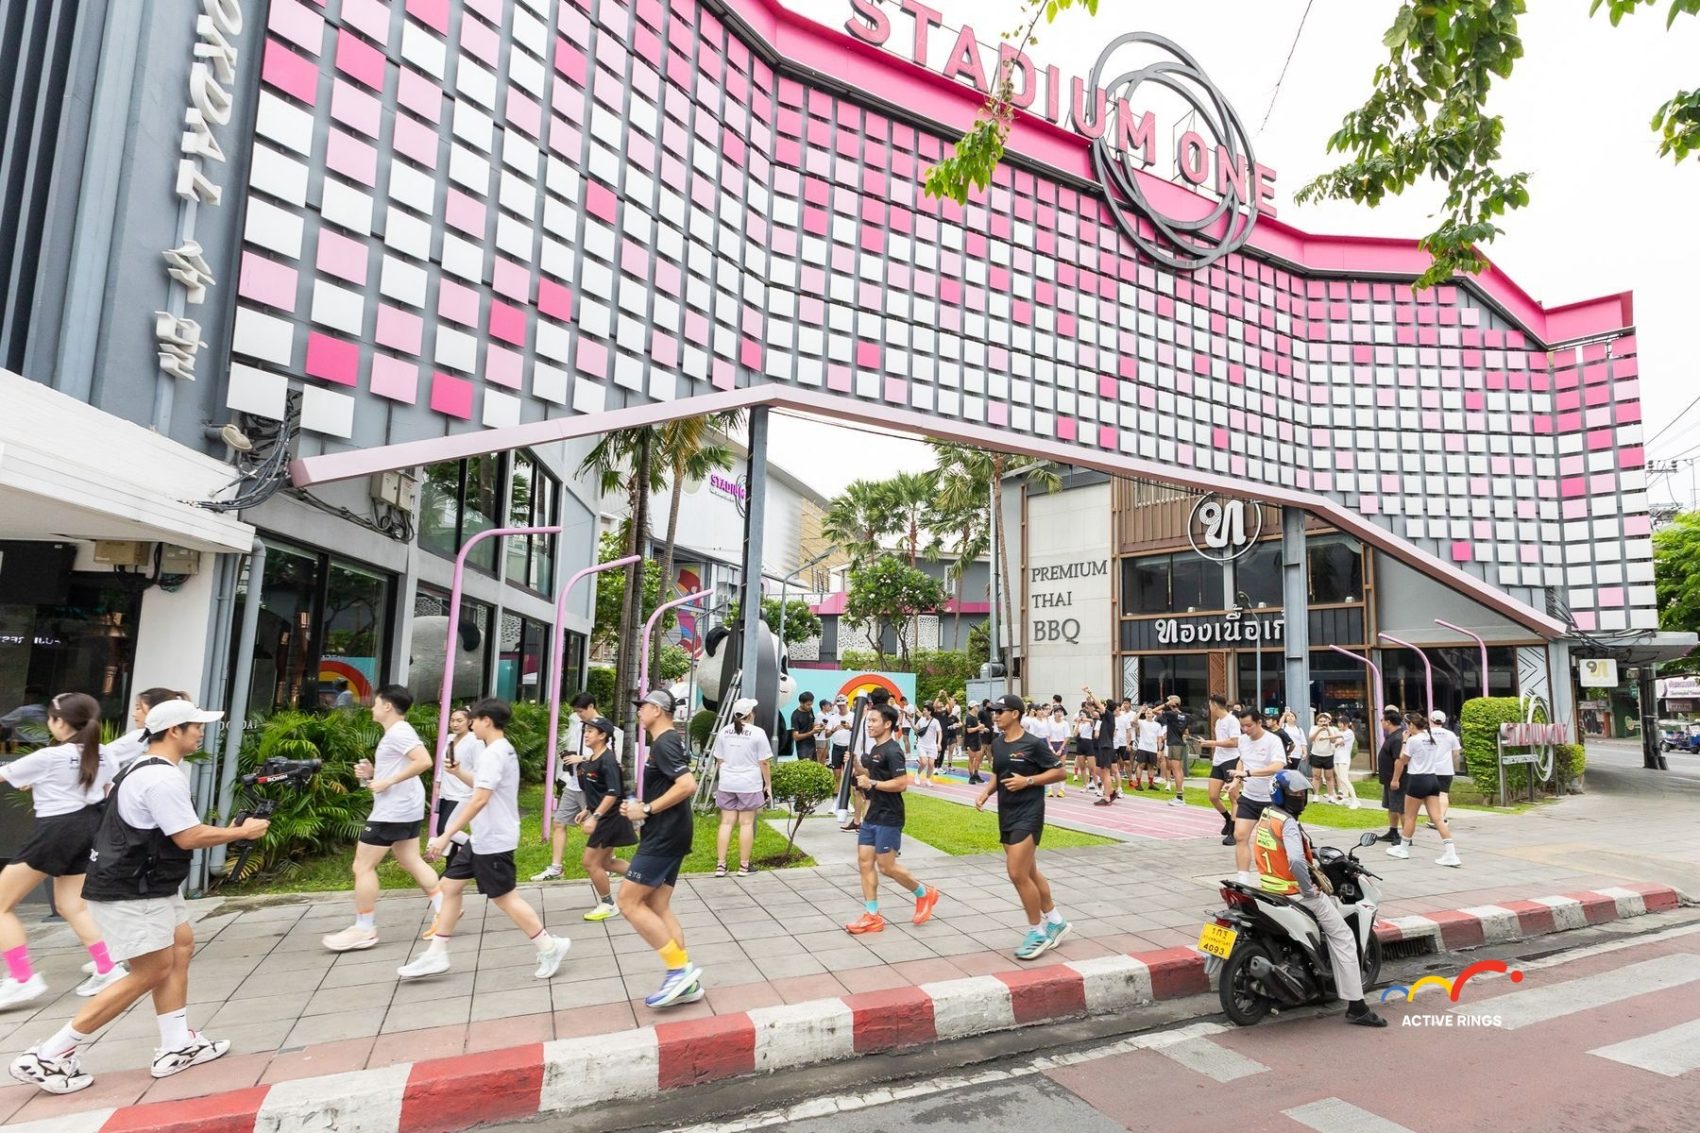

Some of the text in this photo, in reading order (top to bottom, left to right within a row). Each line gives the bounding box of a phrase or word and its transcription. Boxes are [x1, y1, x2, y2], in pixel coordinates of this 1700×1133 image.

[844, 0, 1278, 218] STADIUM ONE
[1031, 560, 1108, 582] PREMIUM
[1031, 591, 1072, 608] THAI
[1033, 618, 1080, 645] BBQ
[1203, 942, 1225, 956] 4093
